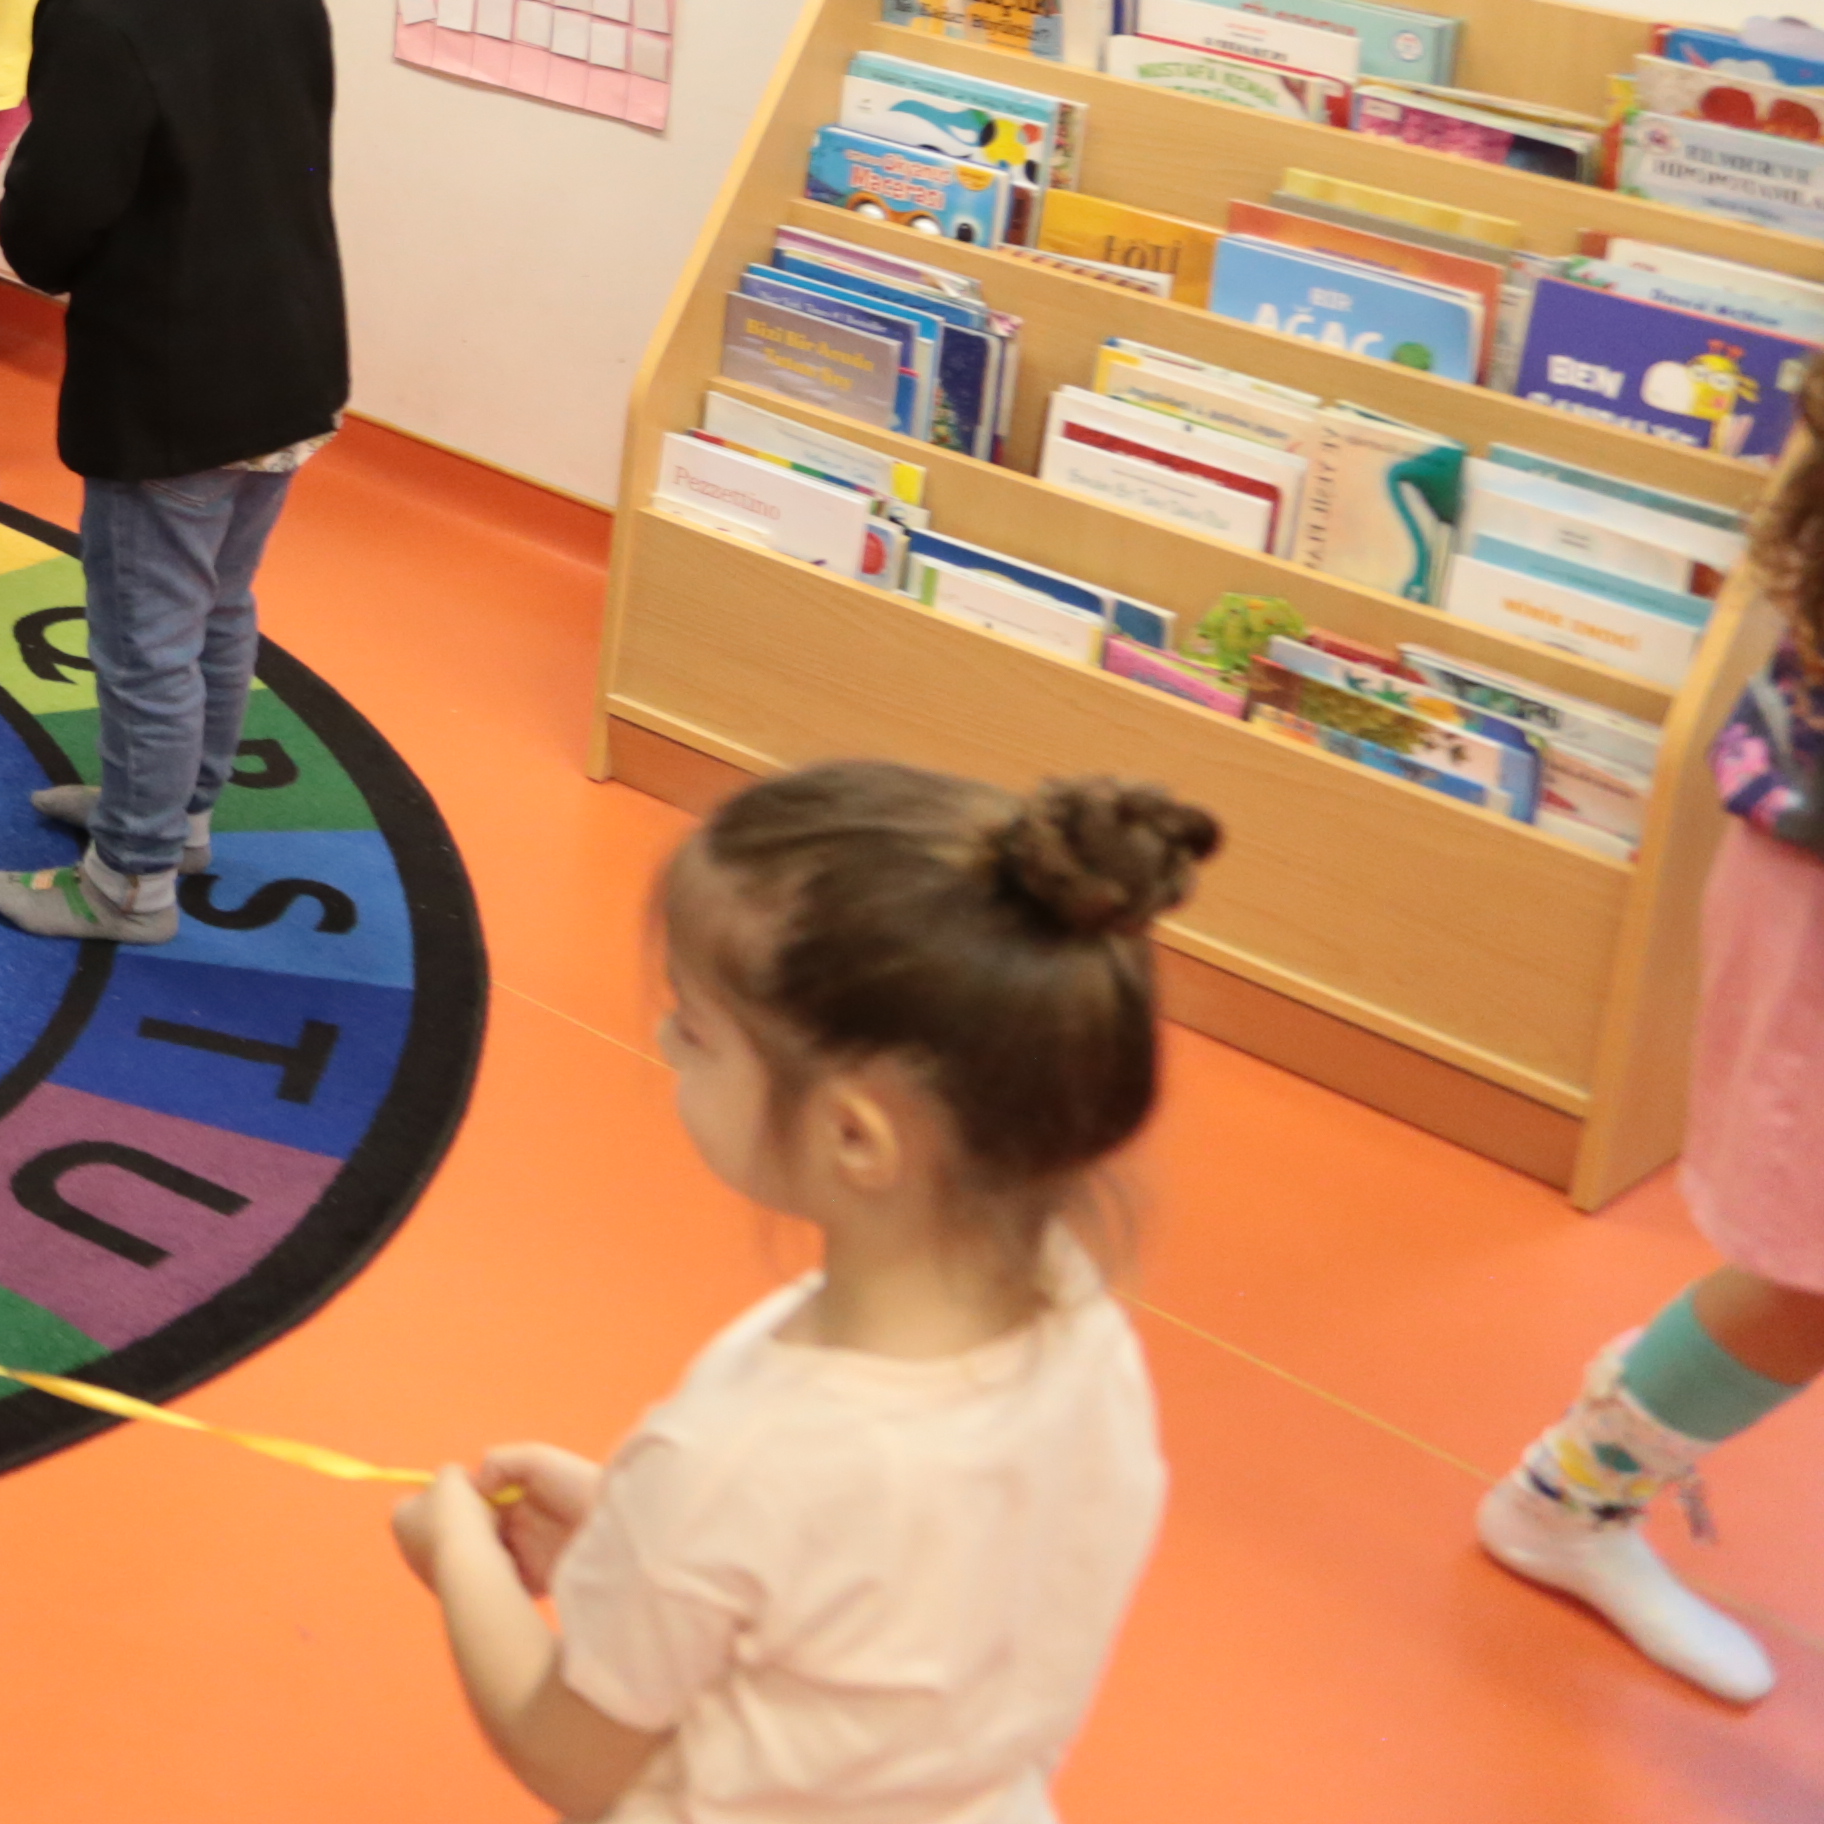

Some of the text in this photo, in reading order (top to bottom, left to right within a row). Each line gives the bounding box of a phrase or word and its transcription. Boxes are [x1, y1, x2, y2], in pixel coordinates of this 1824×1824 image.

[1546, 353, 1626, 401] BEN
[672, 463, 782, 522] Pezzettino
[180, 872, 358, 936] S
[136, 1015, 340, 1104] T
[9, 1140, 252, 1270] U
